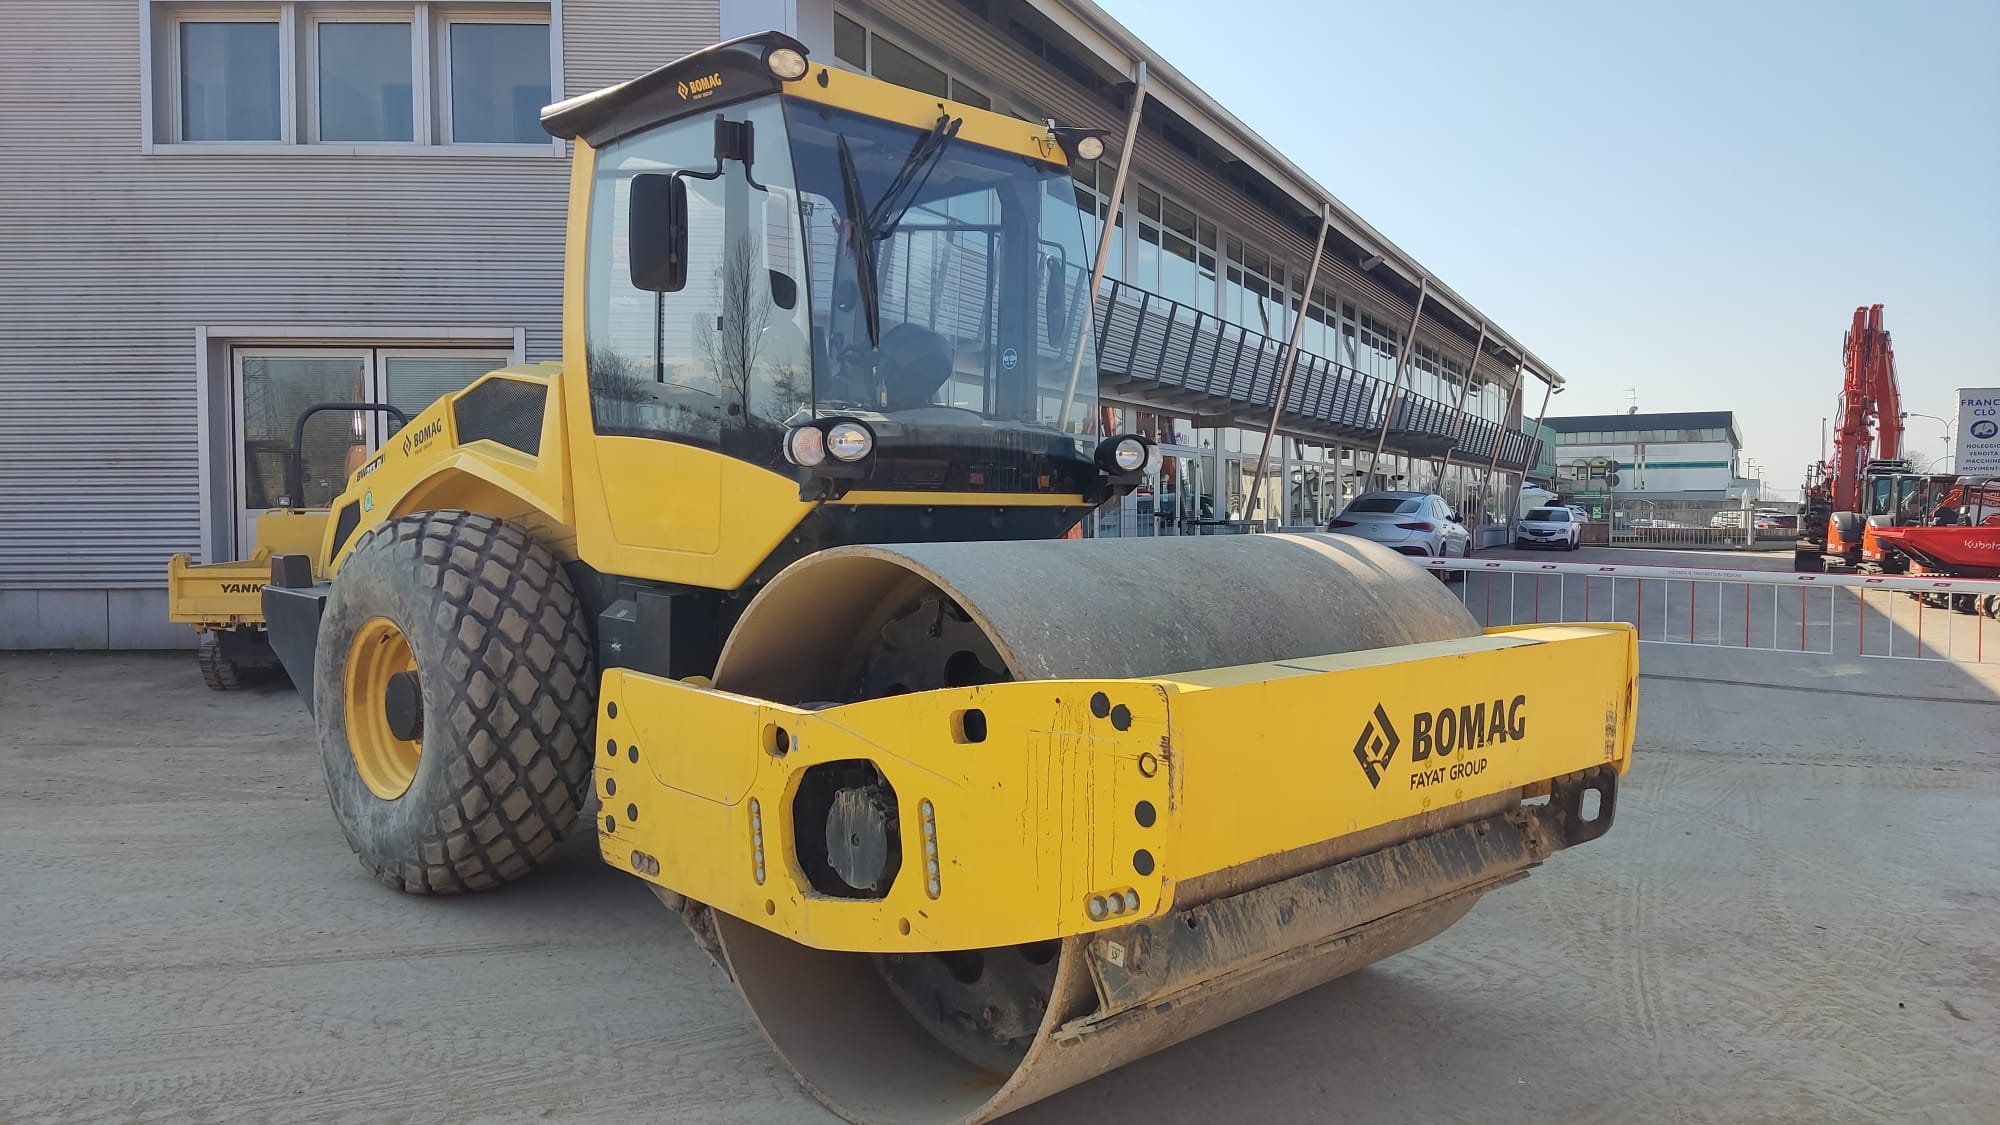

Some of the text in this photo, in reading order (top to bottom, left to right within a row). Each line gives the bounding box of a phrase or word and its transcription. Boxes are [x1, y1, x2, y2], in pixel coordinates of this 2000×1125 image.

[689, 73, 722, 93] BOMAG
[414, 417, 442, 448] BOMAG
[1411, 695, 1526, 762] BOMAG
[1410, 758, 1488, 791] FAYAT GROUP
